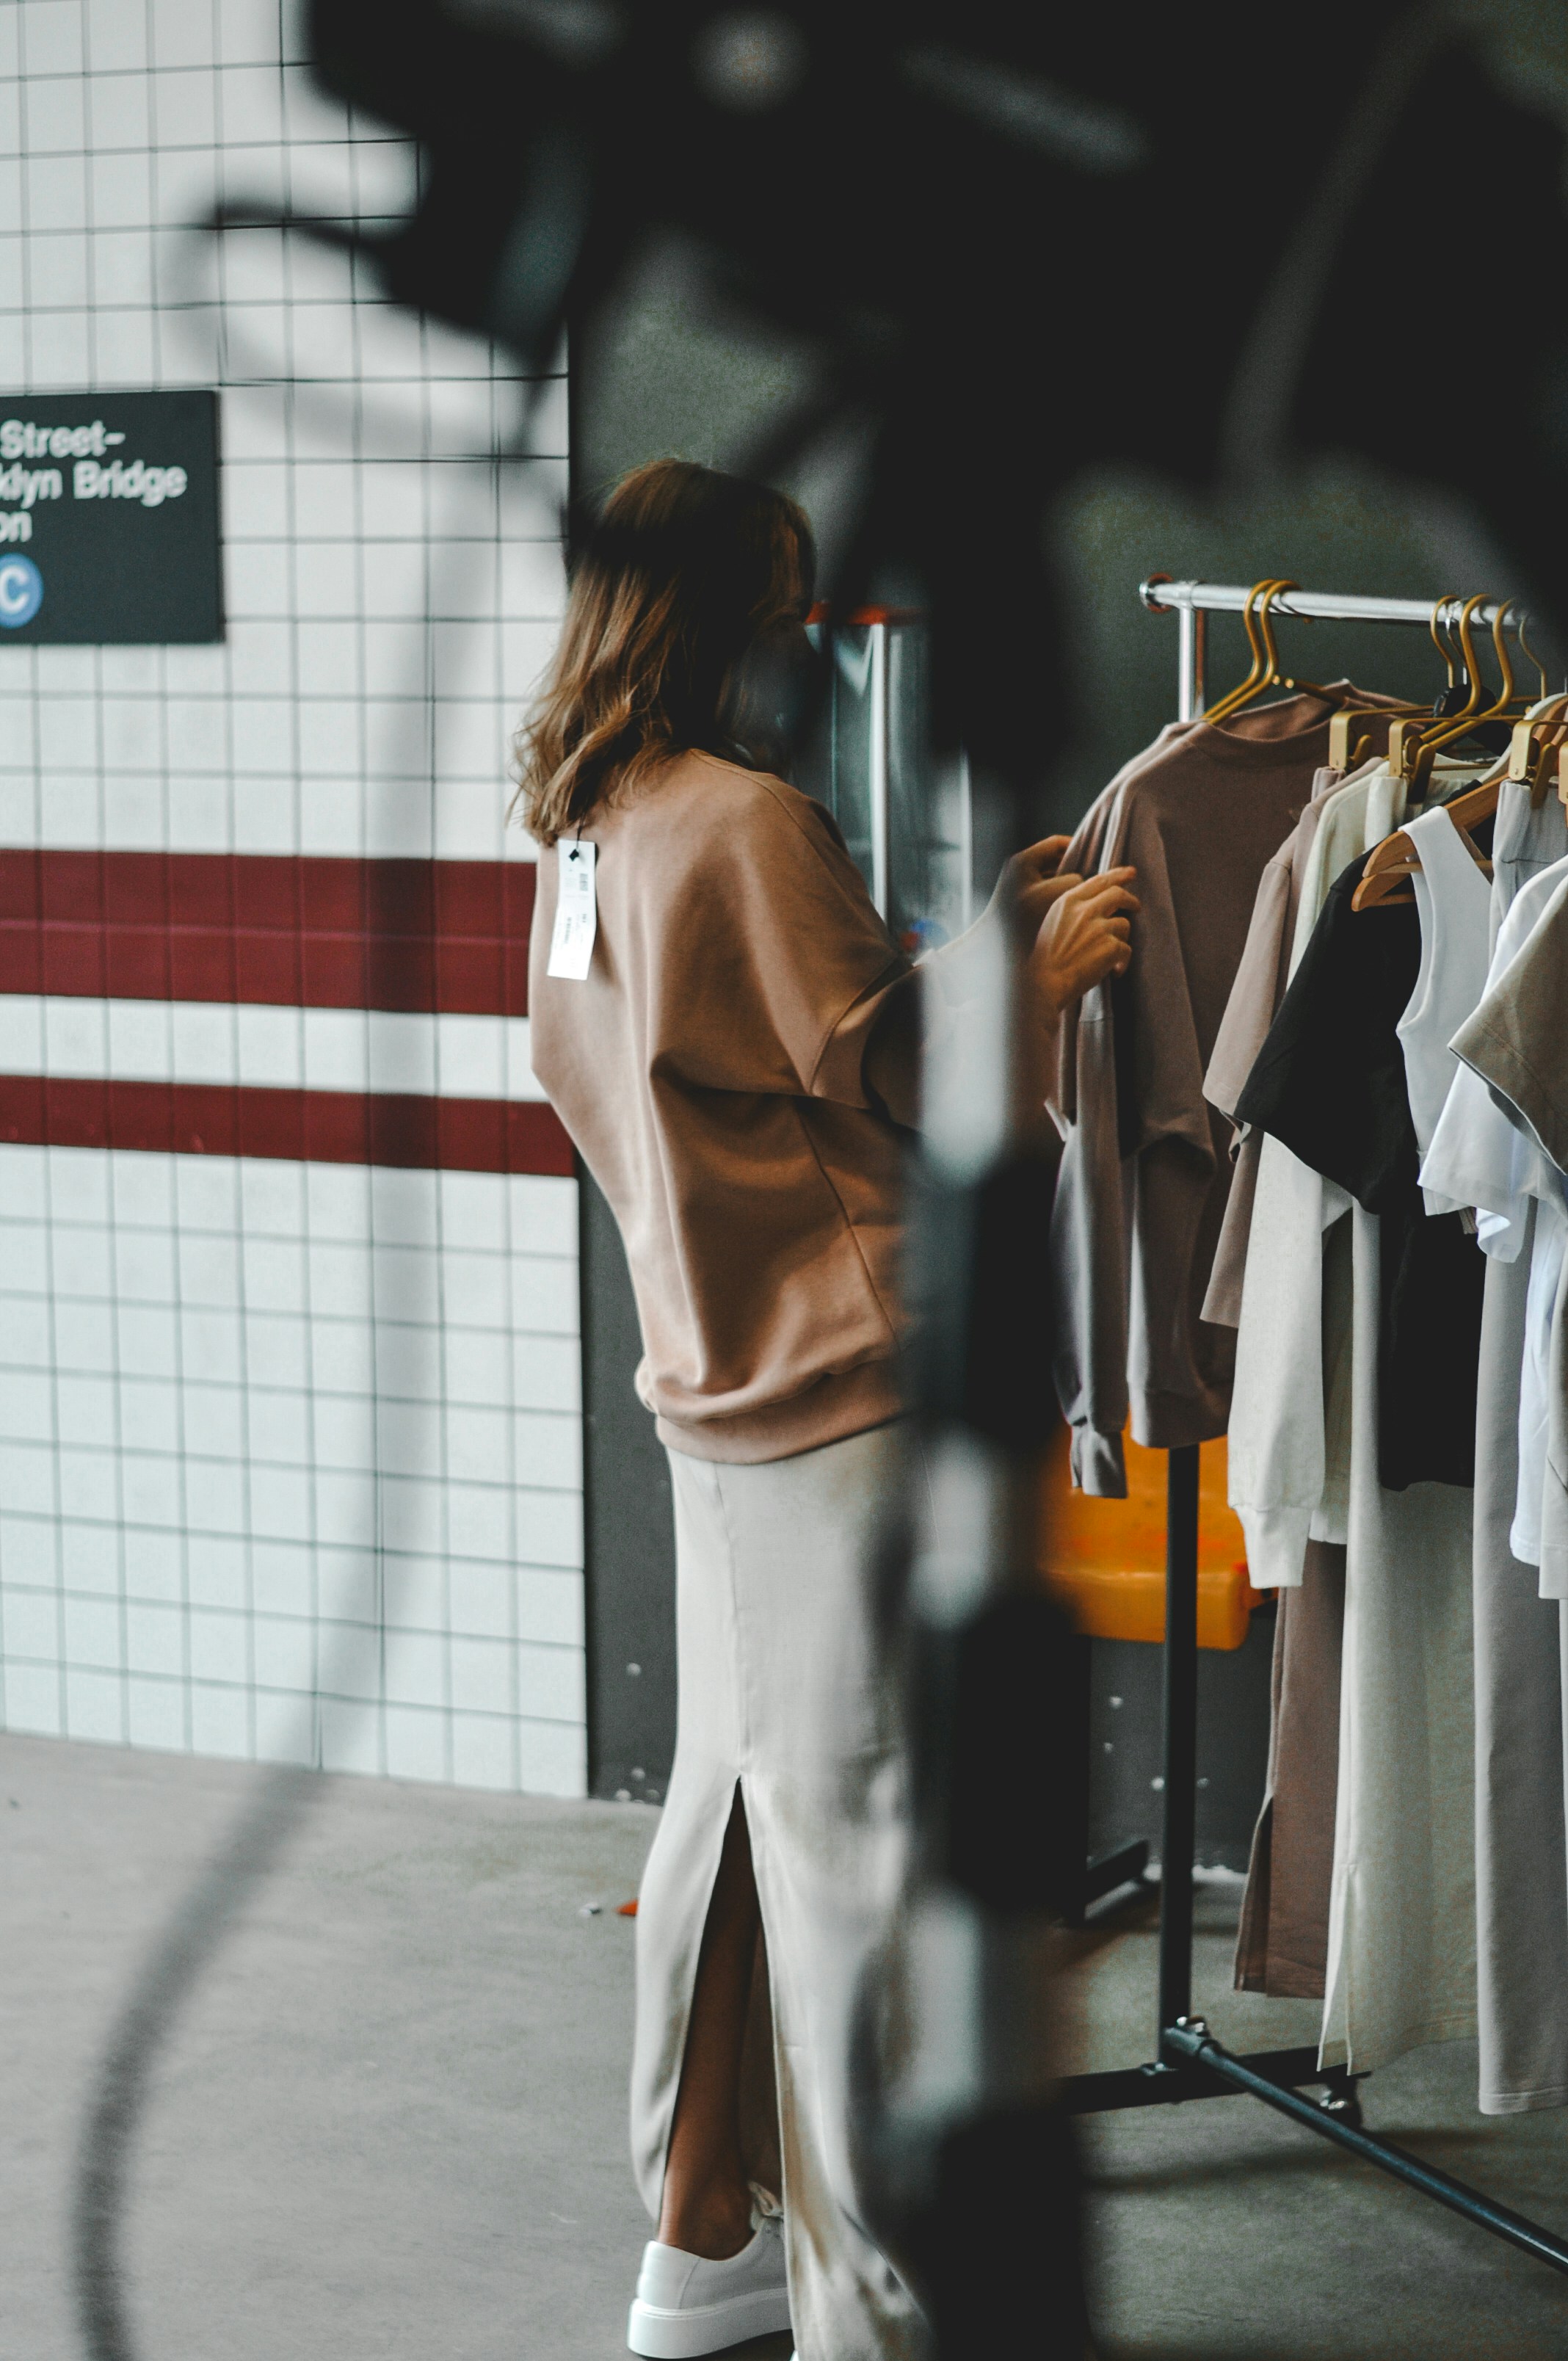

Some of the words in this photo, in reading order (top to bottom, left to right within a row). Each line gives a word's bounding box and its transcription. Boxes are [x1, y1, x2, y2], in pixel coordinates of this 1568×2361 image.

[0, 419, 126, 459] Street-
[73, 460, 187, 507] Bridge
[0, 565, 29, 612] C
